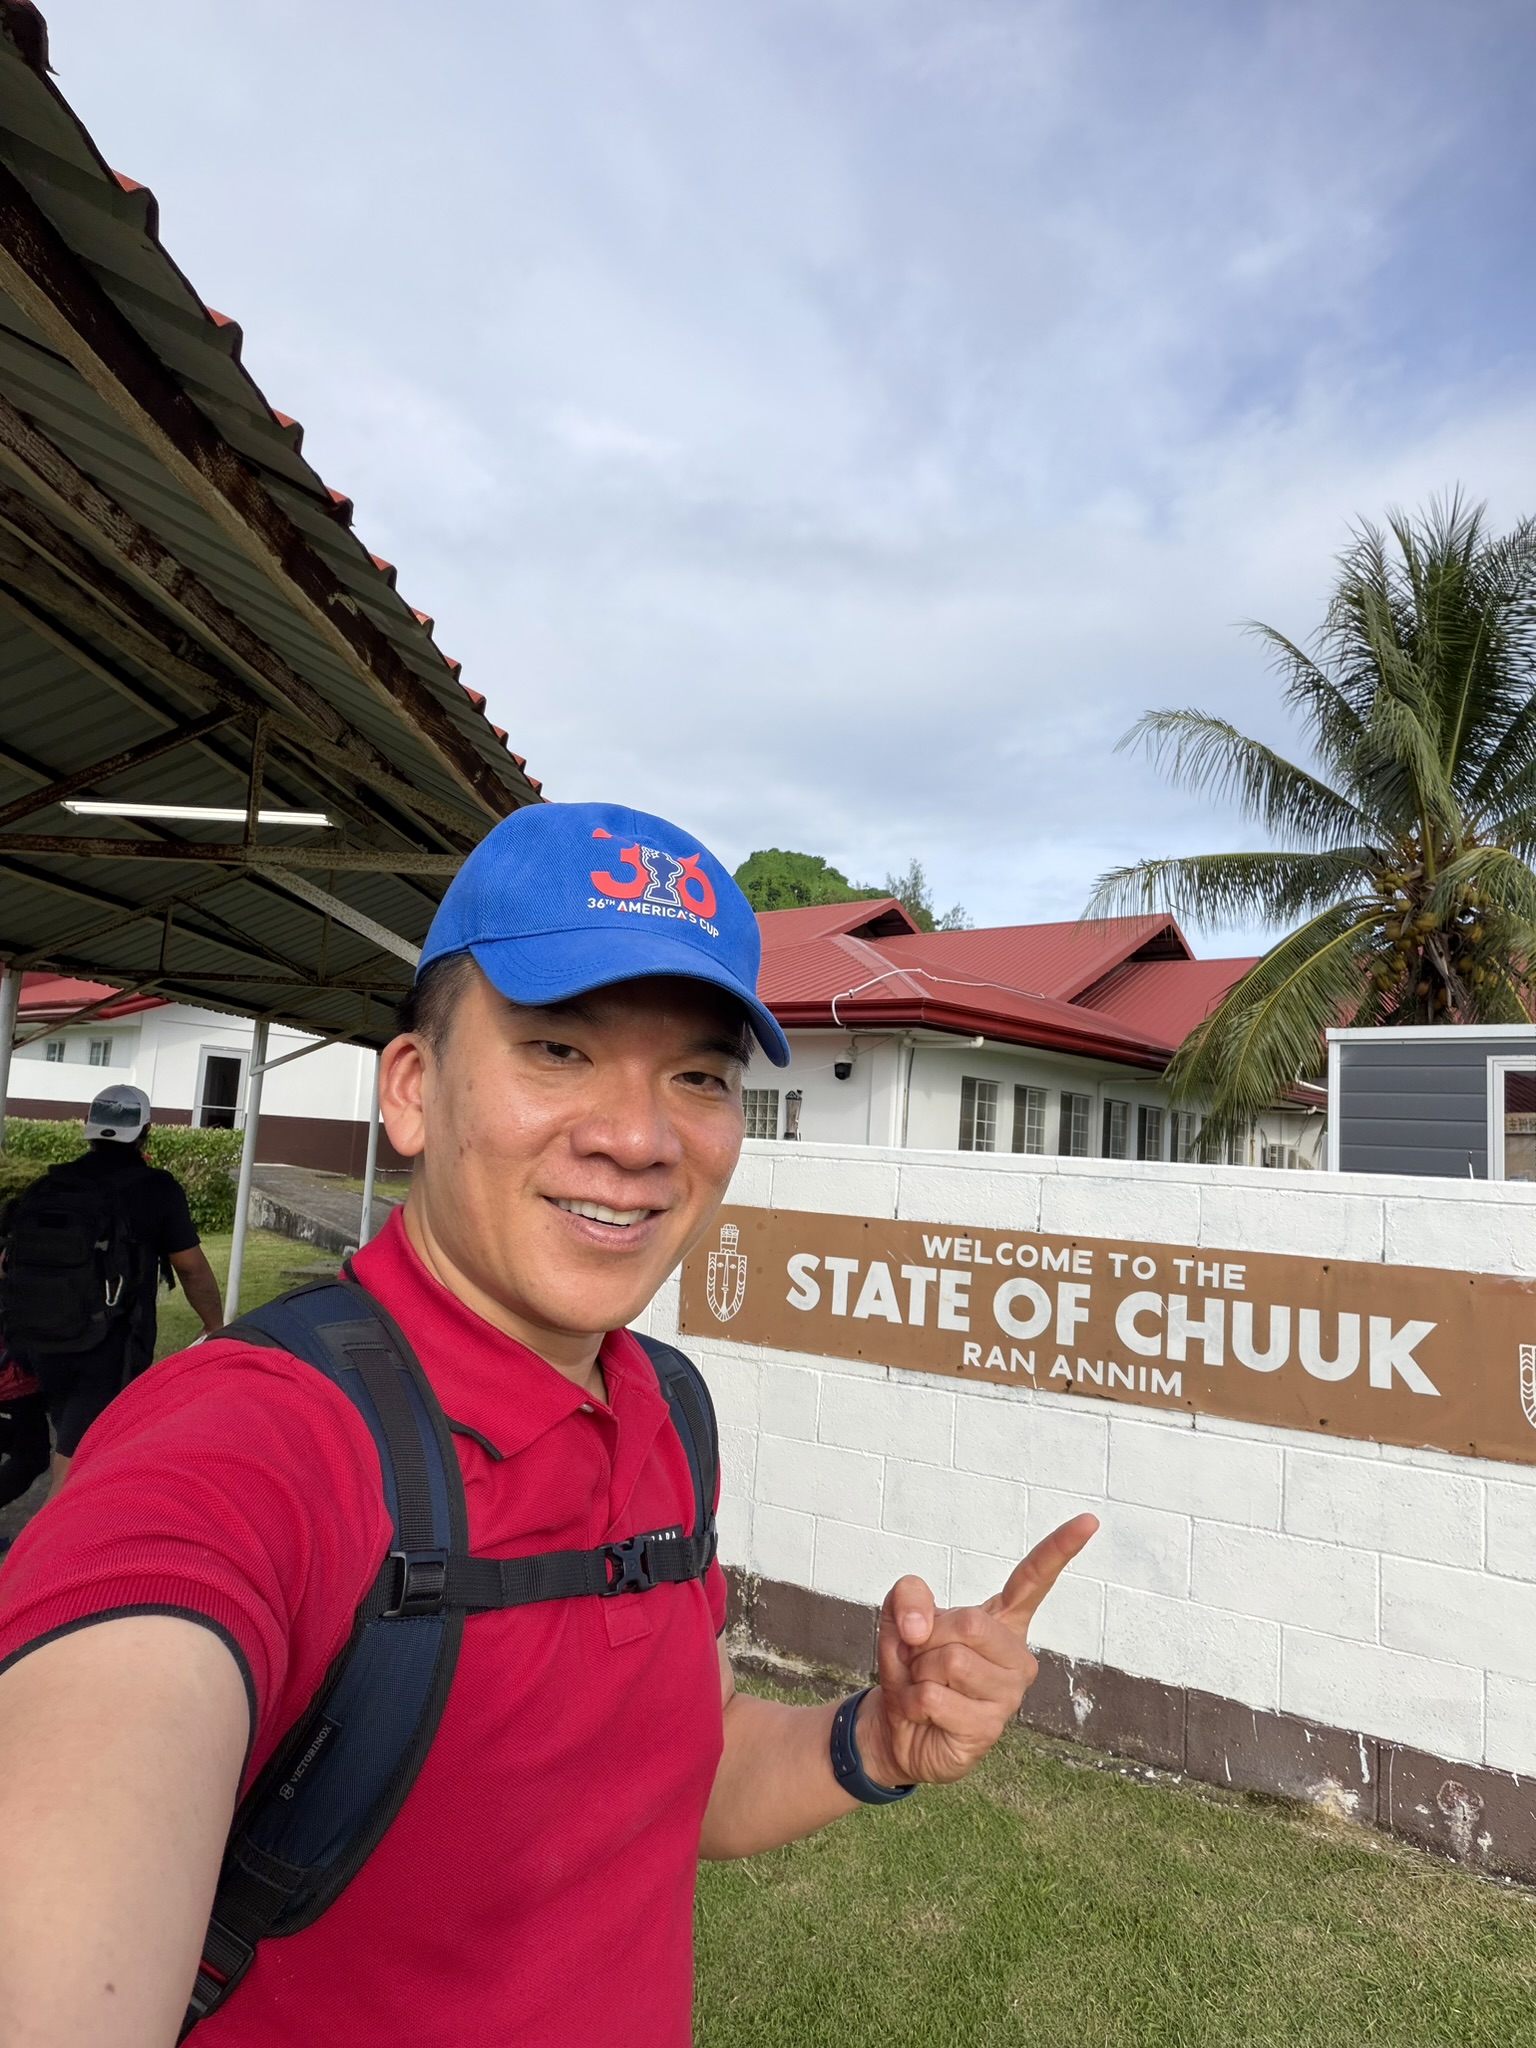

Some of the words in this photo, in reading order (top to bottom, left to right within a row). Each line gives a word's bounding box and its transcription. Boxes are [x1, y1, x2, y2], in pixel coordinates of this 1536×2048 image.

[617, 901, 697, 923] AMERICA'S
[699, 918, 719, 937] CUP
[923, 1234, 1094, 1275] WELCOME
[1109, 1253, 1157, 1280] TO
[1173, 1258, 1247, 1291] THE
[785, 1253, 972, 1332] STATE
[992, 1277, 1091, 1346] OF
[1114, 1291, 1441, 1397] CHUUK
[964, 1341, 1036, 1375] RAN
[1049, 1355, 1182, 1398] ANNIM
[290, 1724, 332, 1782] VICTORINOX
